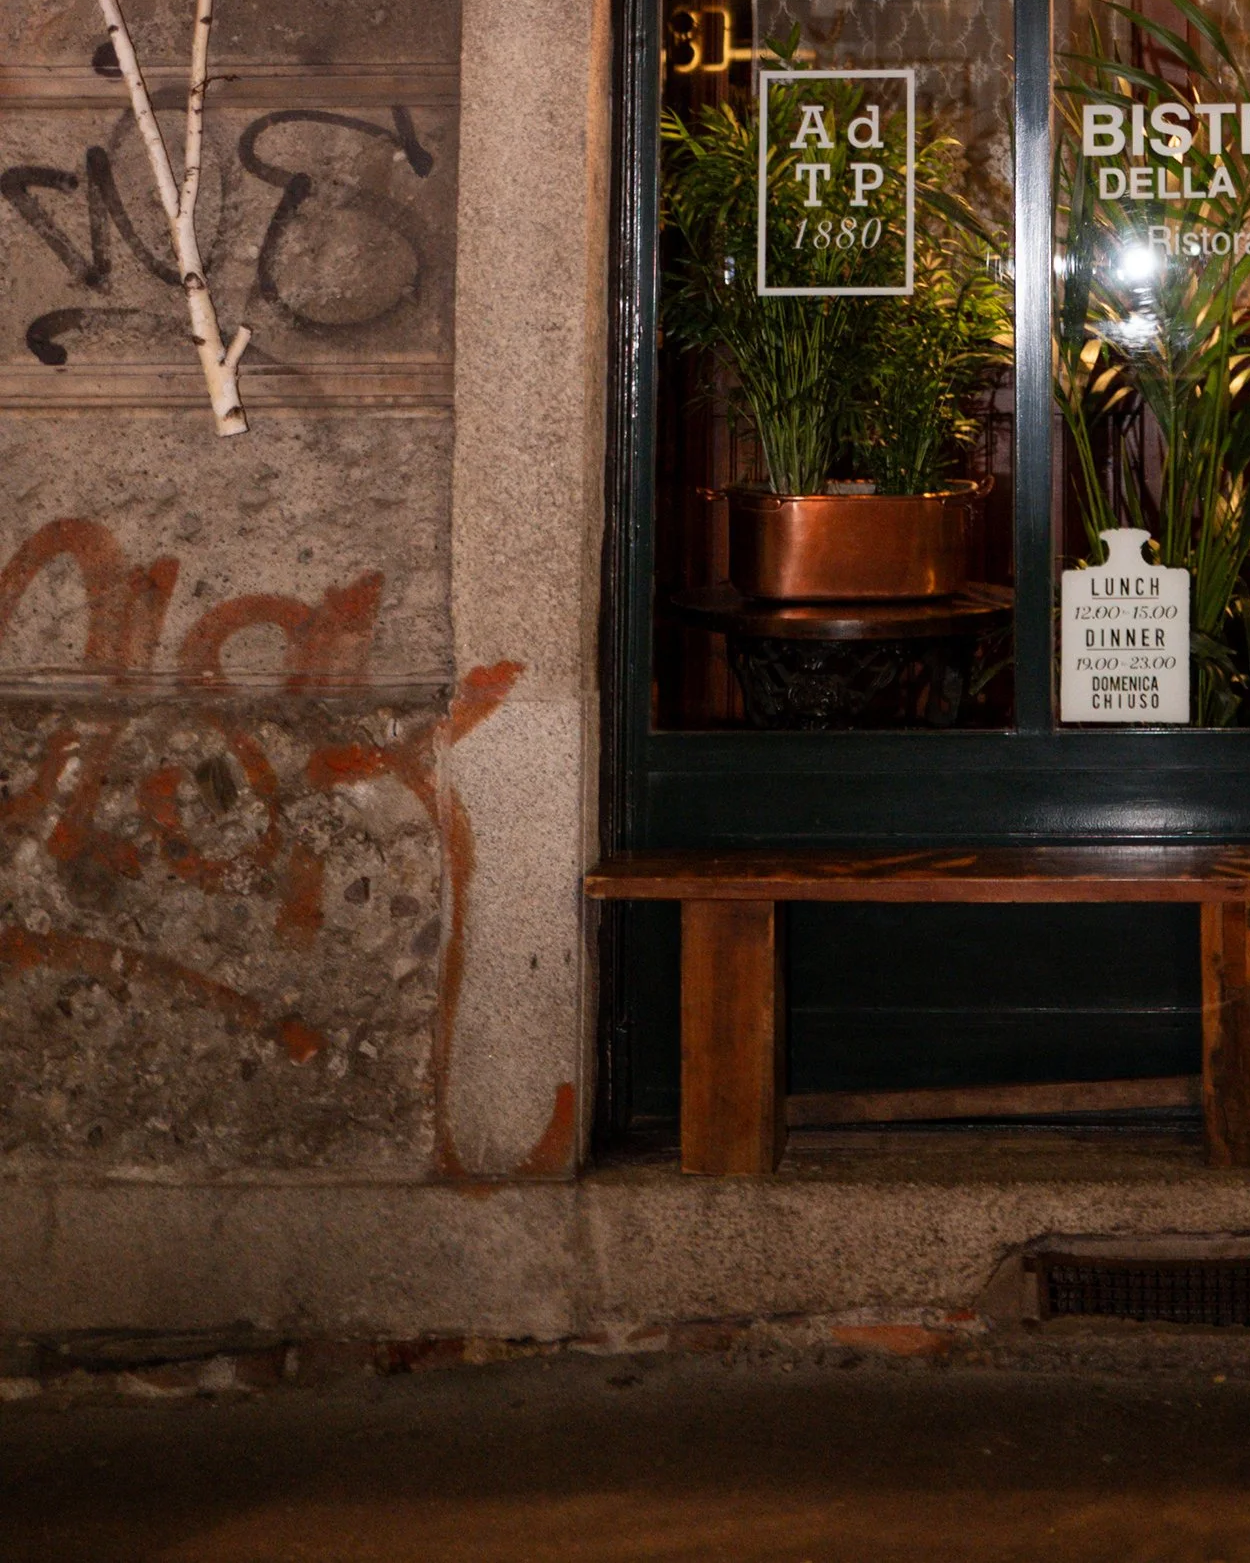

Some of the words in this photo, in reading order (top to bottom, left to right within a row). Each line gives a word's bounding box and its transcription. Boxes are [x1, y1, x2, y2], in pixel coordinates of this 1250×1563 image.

[1099, 166, 1237, 200] DELLA
[792, 216, 882, 250] 1880
[1091, 577, 1160, 596] LUNCH
[1074, 605, 1120, 620] 12.00
[1133, 605, 1178, 619] 15.00
[1086, 628, 1165, 647] DINNER
[1076, 657, 1119, 671] 19.00
[1130, 656, 1176, 670] 23.00
[1092, 676, 1159, 692] DOMENICA
[1092, 693, 1160, 709] CHIUSO
